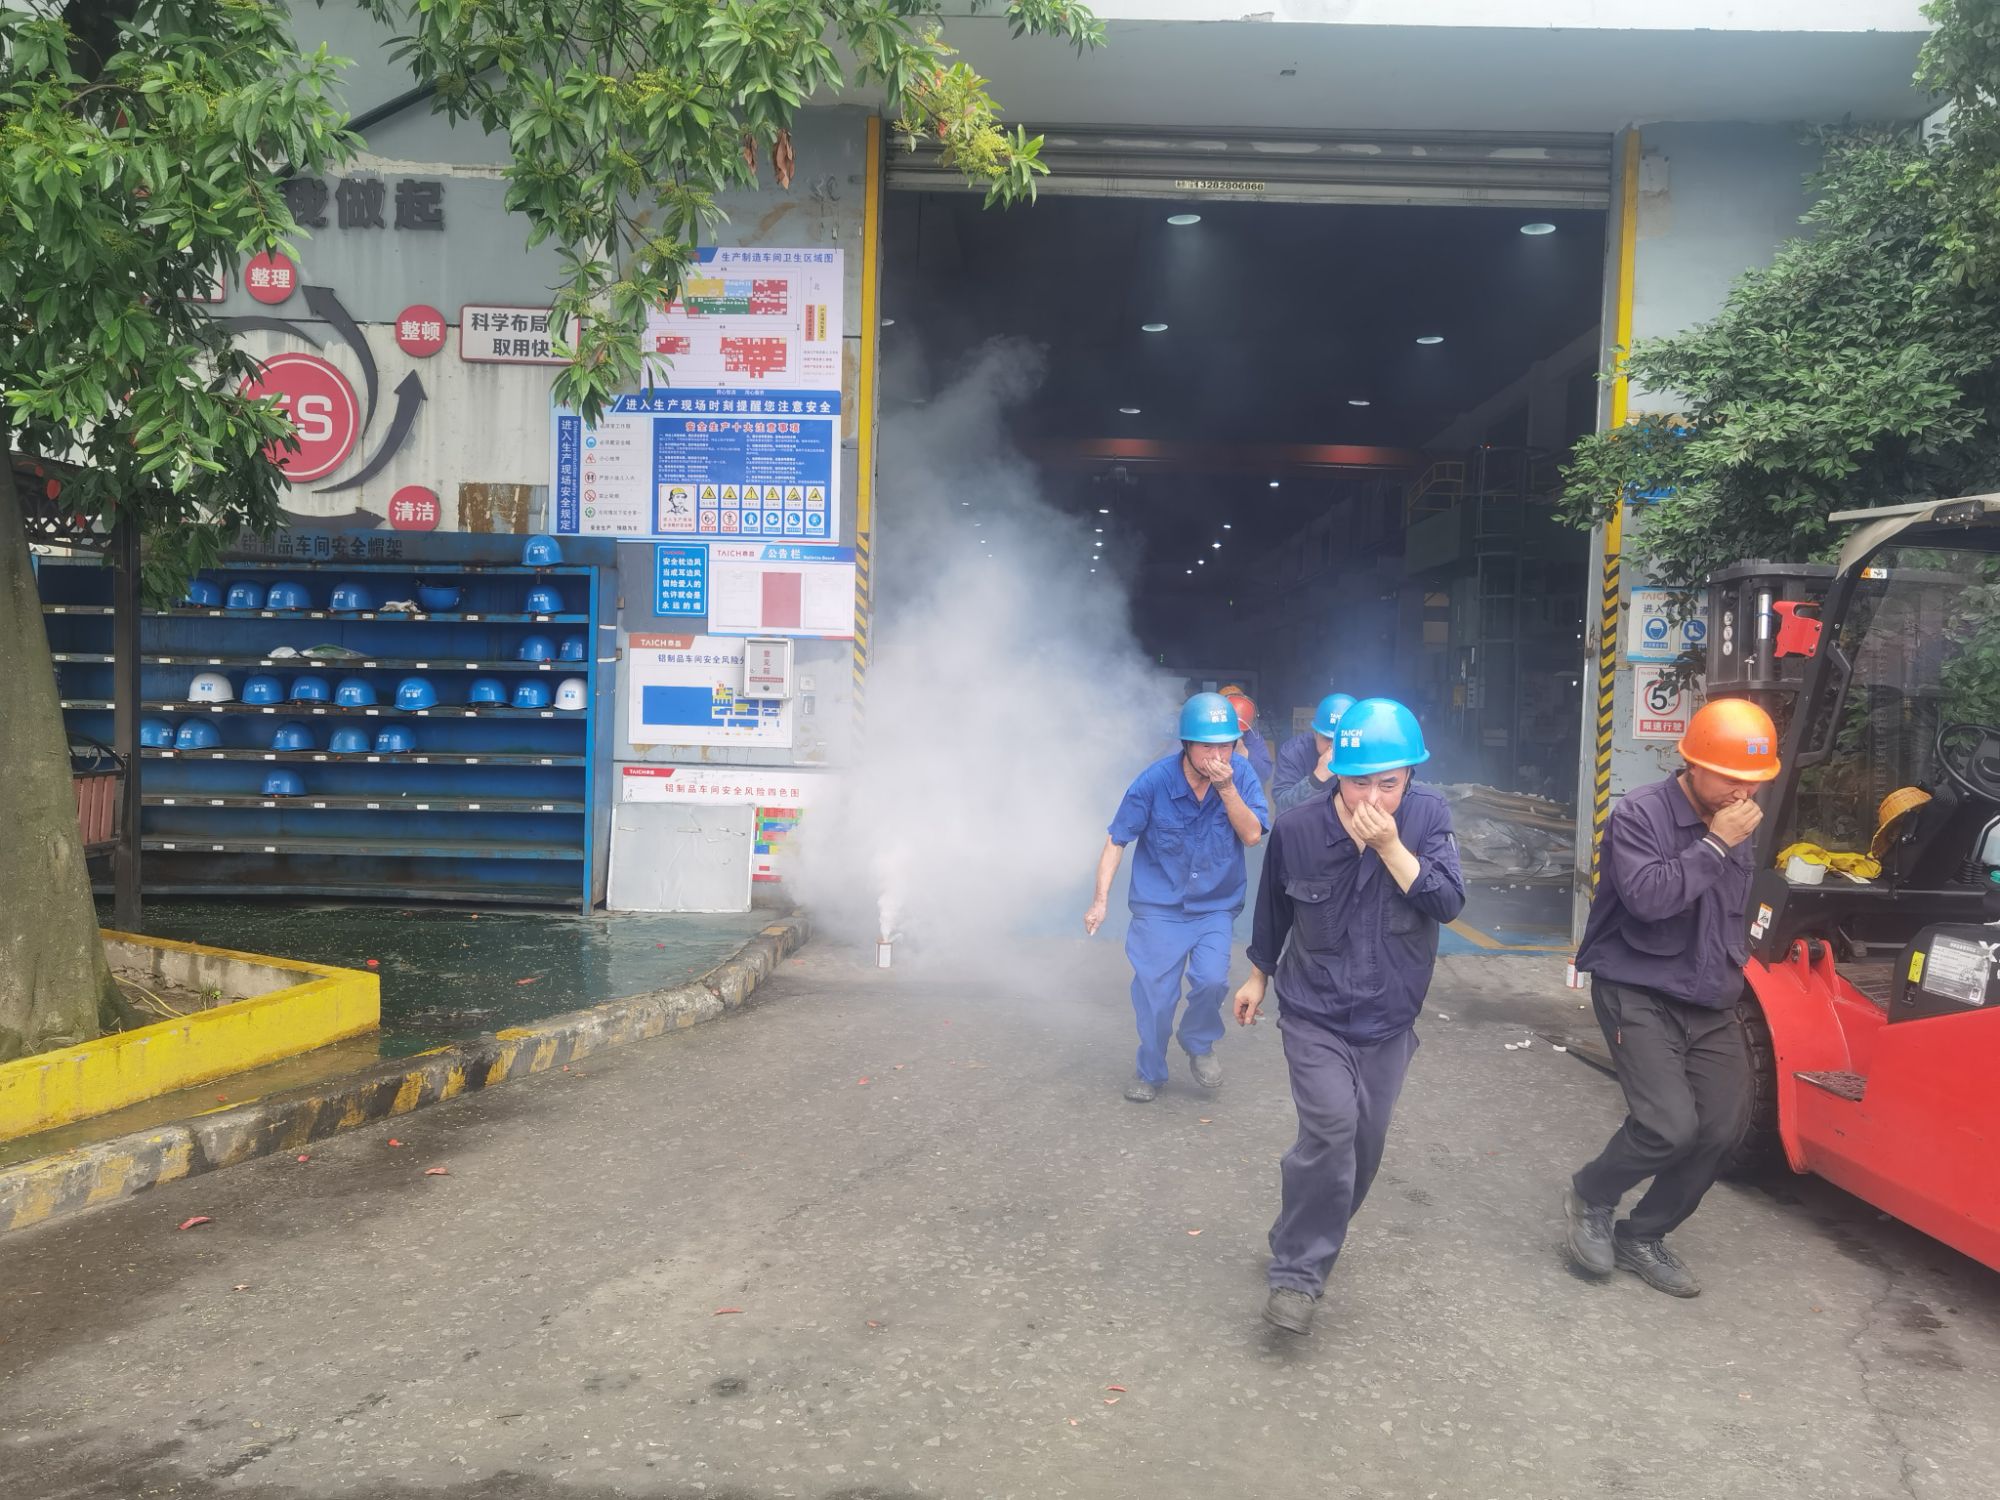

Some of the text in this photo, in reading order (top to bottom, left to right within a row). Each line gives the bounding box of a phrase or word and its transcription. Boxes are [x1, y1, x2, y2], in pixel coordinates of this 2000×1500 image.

[721, 252, 834, 264] 生产制造车间卫生区域图
[250, 267, 291, 289] 整理
[400, 320, 442, 343] 整顿
[471, 312, 548, 334] 科学布局
[625, 398, 832, 414] 进入生产现场时刻提醒您注意安全
[685, 421, 801, 434] 安全生产十大注意事项
[560, 419, 572, 531] 进入生产现场安全规定
[394, 500, 435, 522] 清洁
[767, 548, 801, 560] 公告栏
[1651, 686, 1668, 710] 5
[1340, 729, 1363, 737] TAICH
[664, 783, 800, 798] 铝制品车间安全风险四色图
